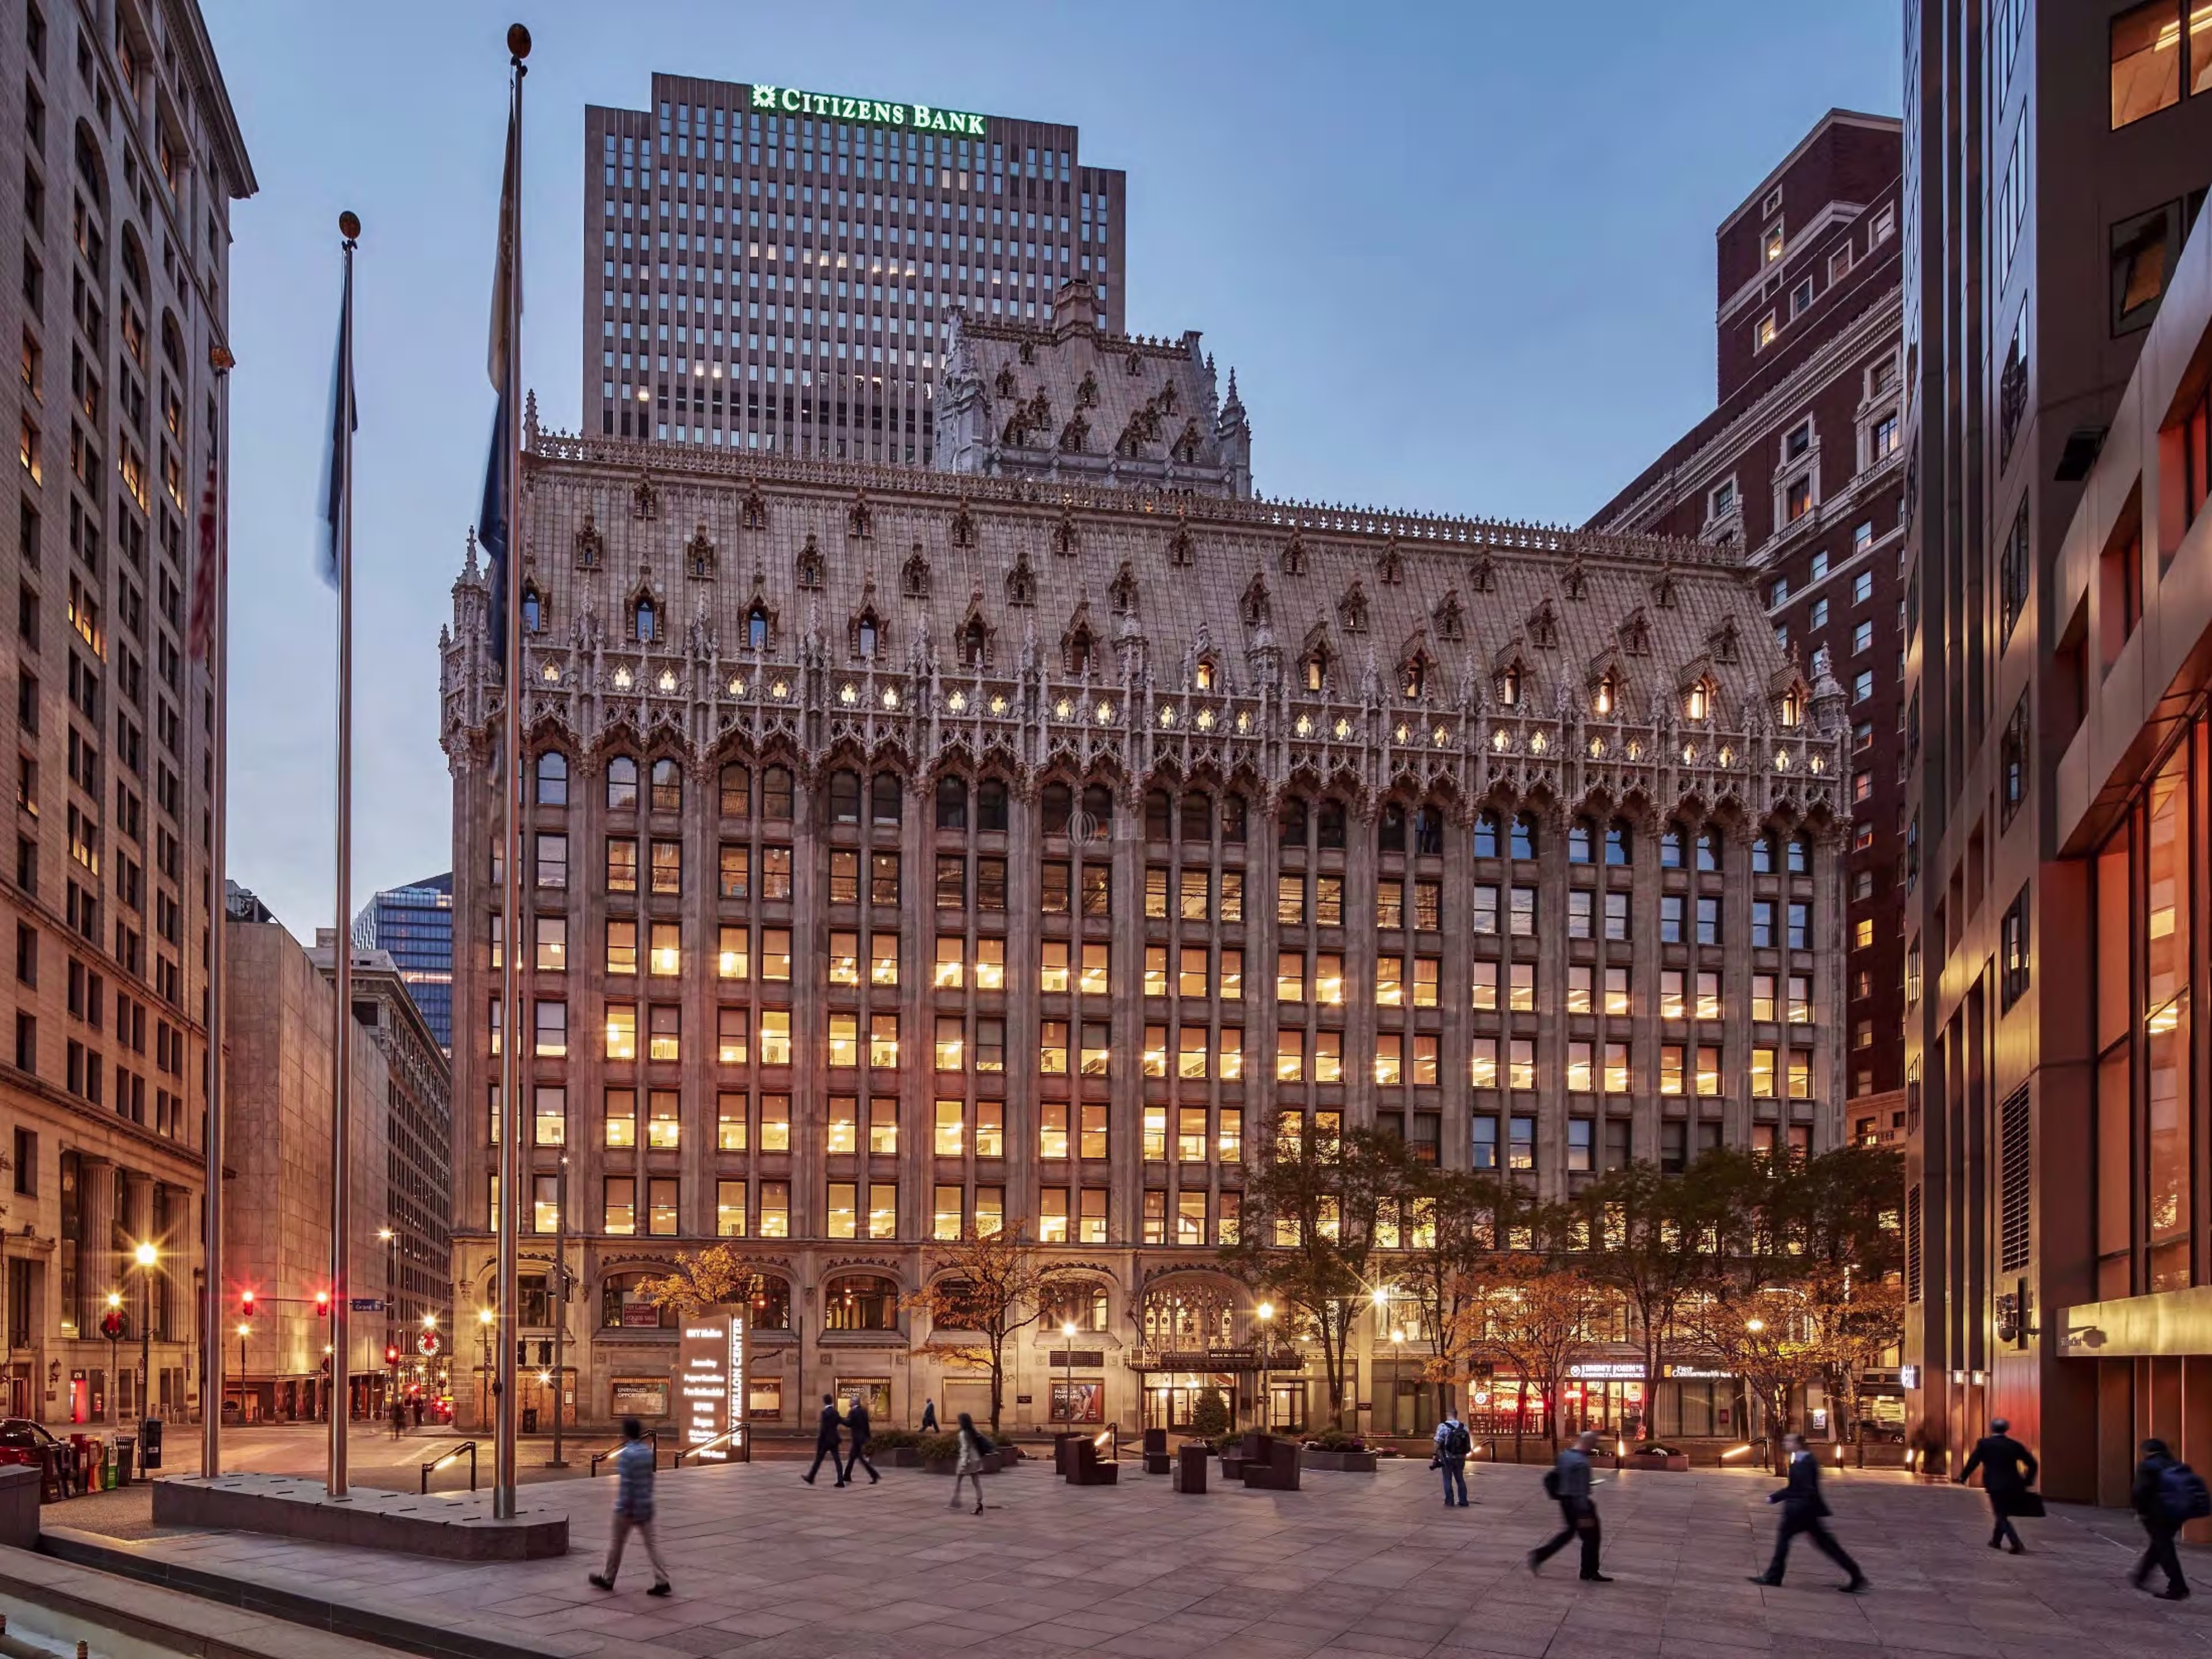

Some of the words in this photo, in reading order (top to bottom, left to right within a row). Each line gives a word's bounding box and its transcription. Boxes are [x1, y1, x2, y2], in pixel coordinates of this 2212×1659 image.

[782, 88, 904, 125] CITIZENS
[912, 104, 986, 135] BANK
[732, 1317, 743, 1366] CENTER
[732, 1368, 743, 1418] MELLON
